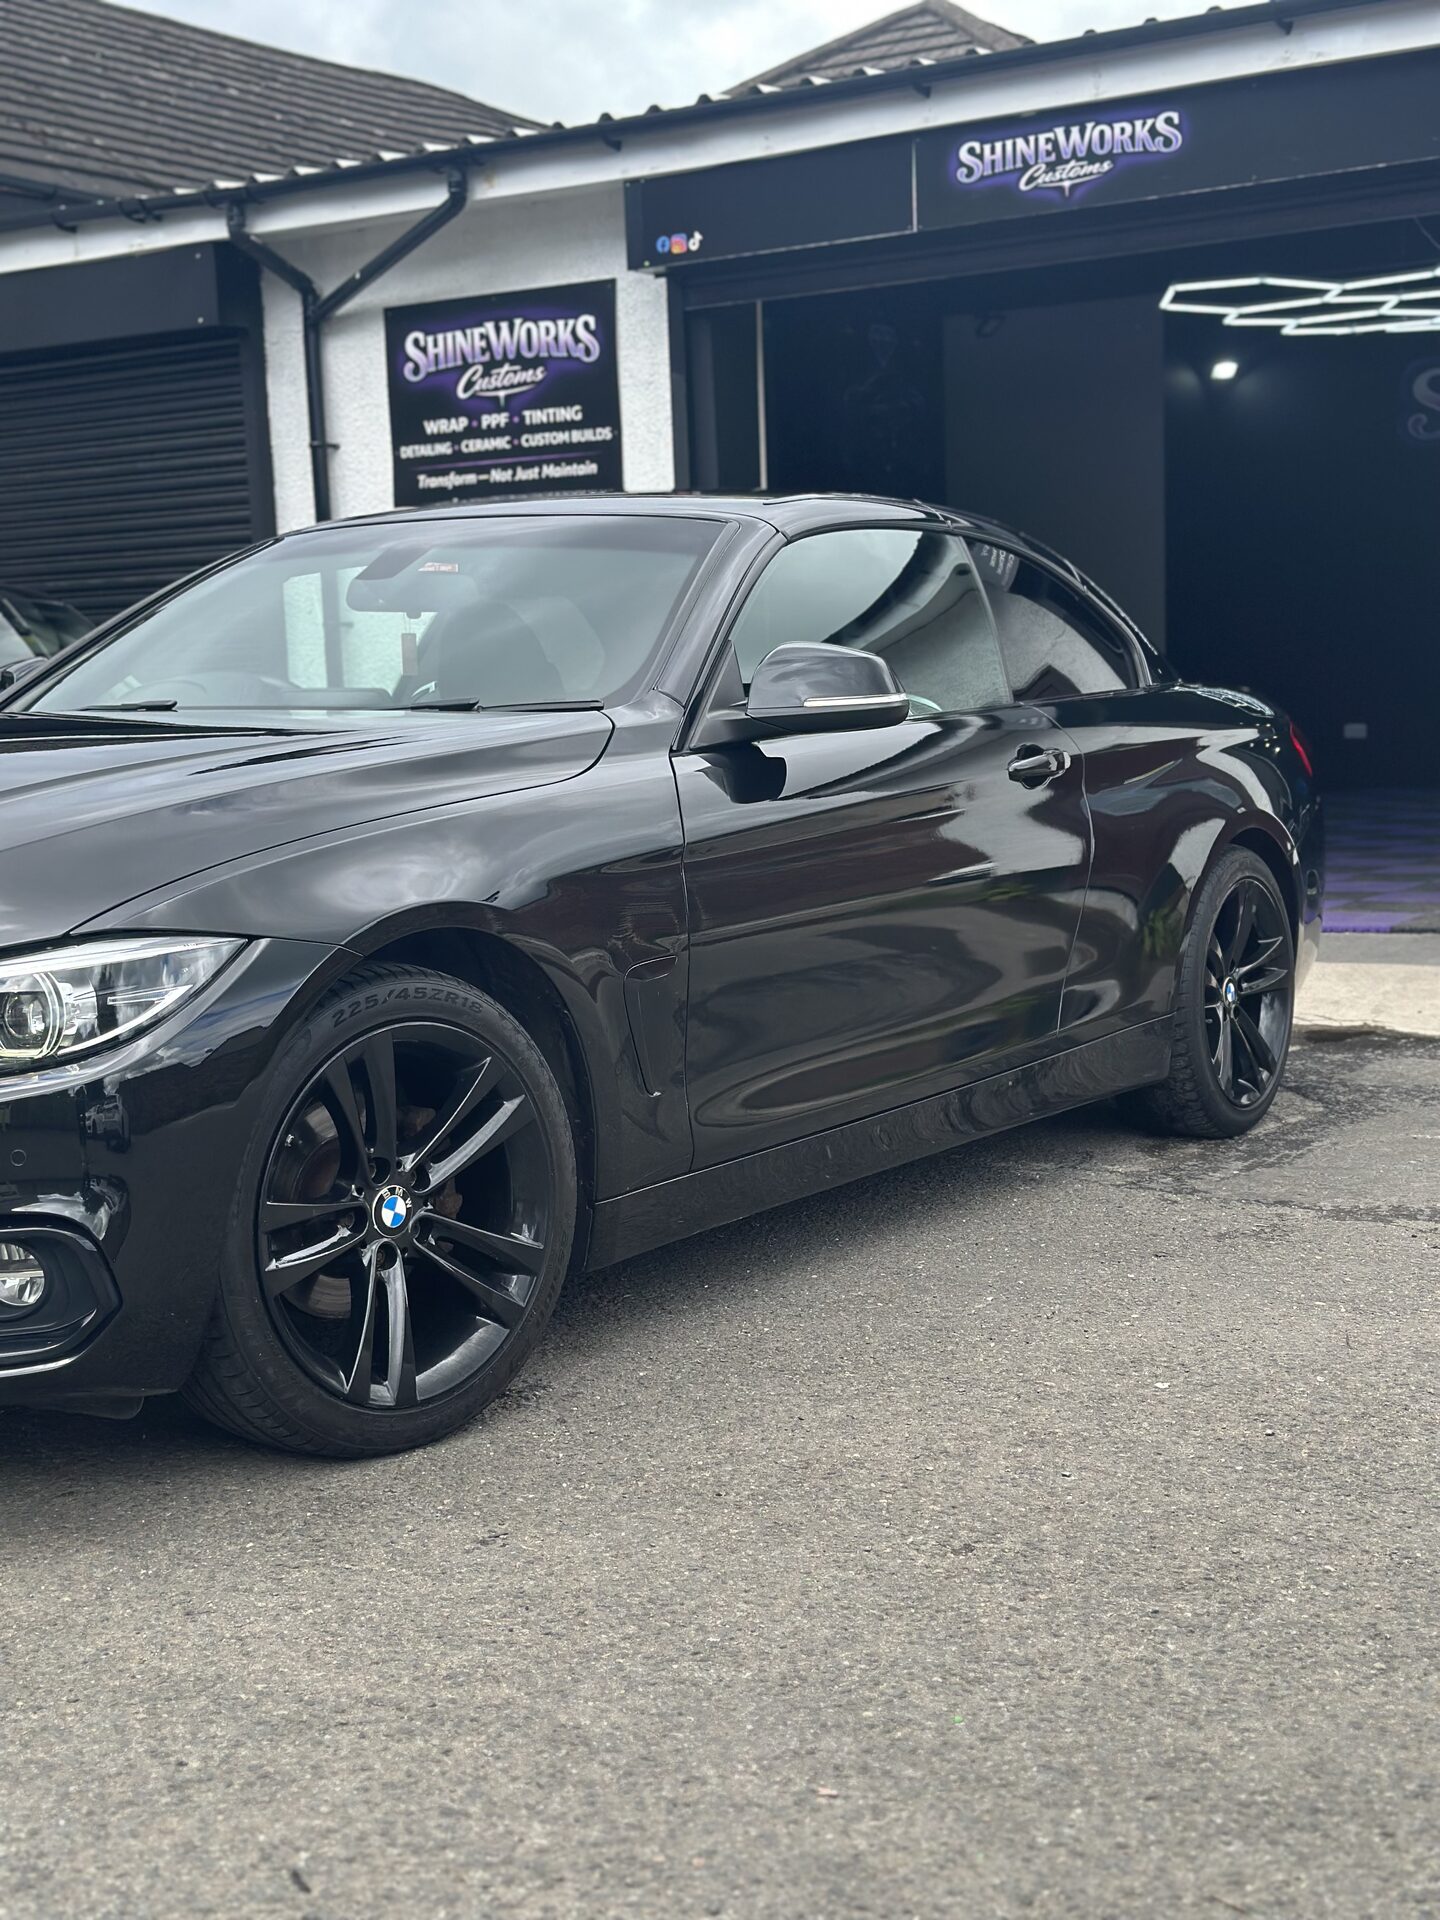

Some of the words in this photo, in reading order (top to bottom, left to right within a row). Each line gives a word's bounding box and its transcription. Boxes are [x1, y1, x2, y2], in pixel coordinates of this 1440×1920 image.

[956, 111, 1183, 184] SHINEWORKS
[1018, 159, 1114, 192] Customs
[403, 313, 600, 382] SHINEWORKS
[456, 362, 547, 399] Customs
[423, 416, 469, 435] WRAP
[481, 412, 510, 430] PPF
[522, 405, 583, 425] TINTING
[400, 442, 453, 459] DETAILING
[461, 435, 511, 453] CERAMIC
[520, 430, 570, 448] CUSTOM
[571, 426, 613, 442] BUILDS
[514, 465, 540, 481] Just
[541, 460, 598, 479] Maintain
